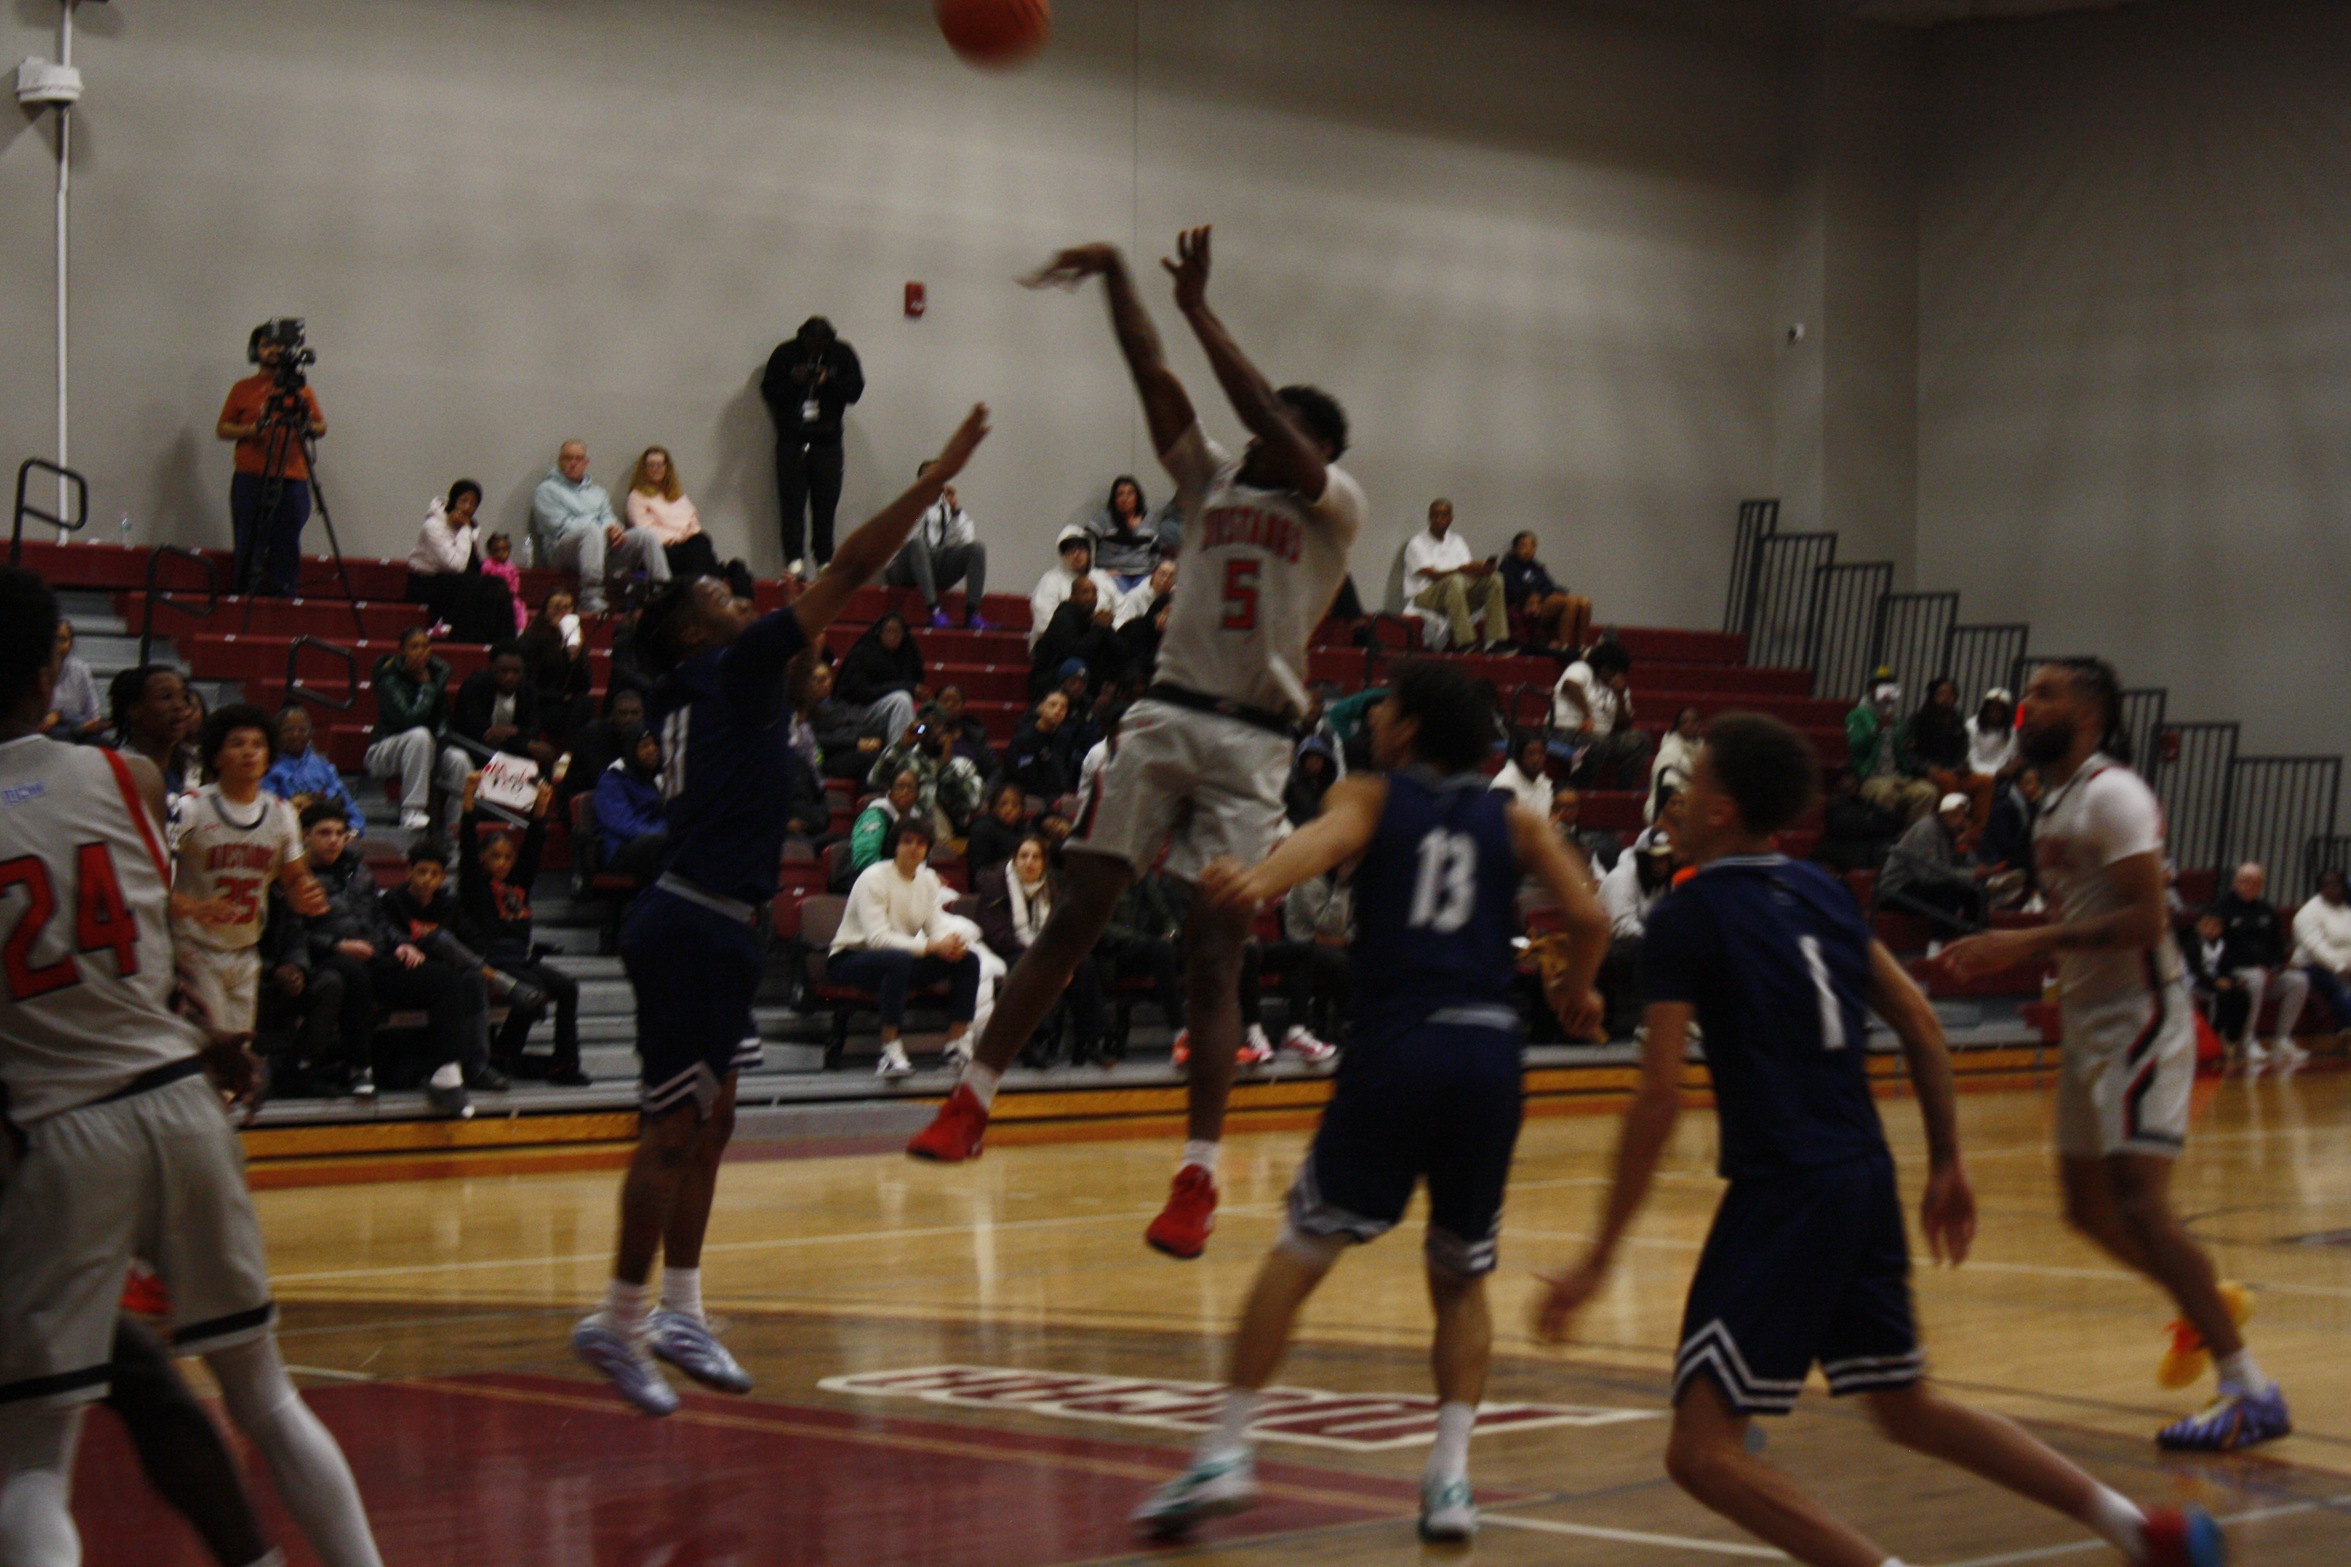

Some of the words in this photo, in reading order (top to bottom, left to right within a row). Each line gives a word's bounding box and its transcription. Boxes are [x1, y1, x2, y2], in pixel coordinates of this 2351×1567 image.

[1222, 557, 1263, 631] 5
[0, 840, 140, 1001] 24
[1407, 826, 1478, 932] 13
[1798, 934, 1846, 1049] 1
